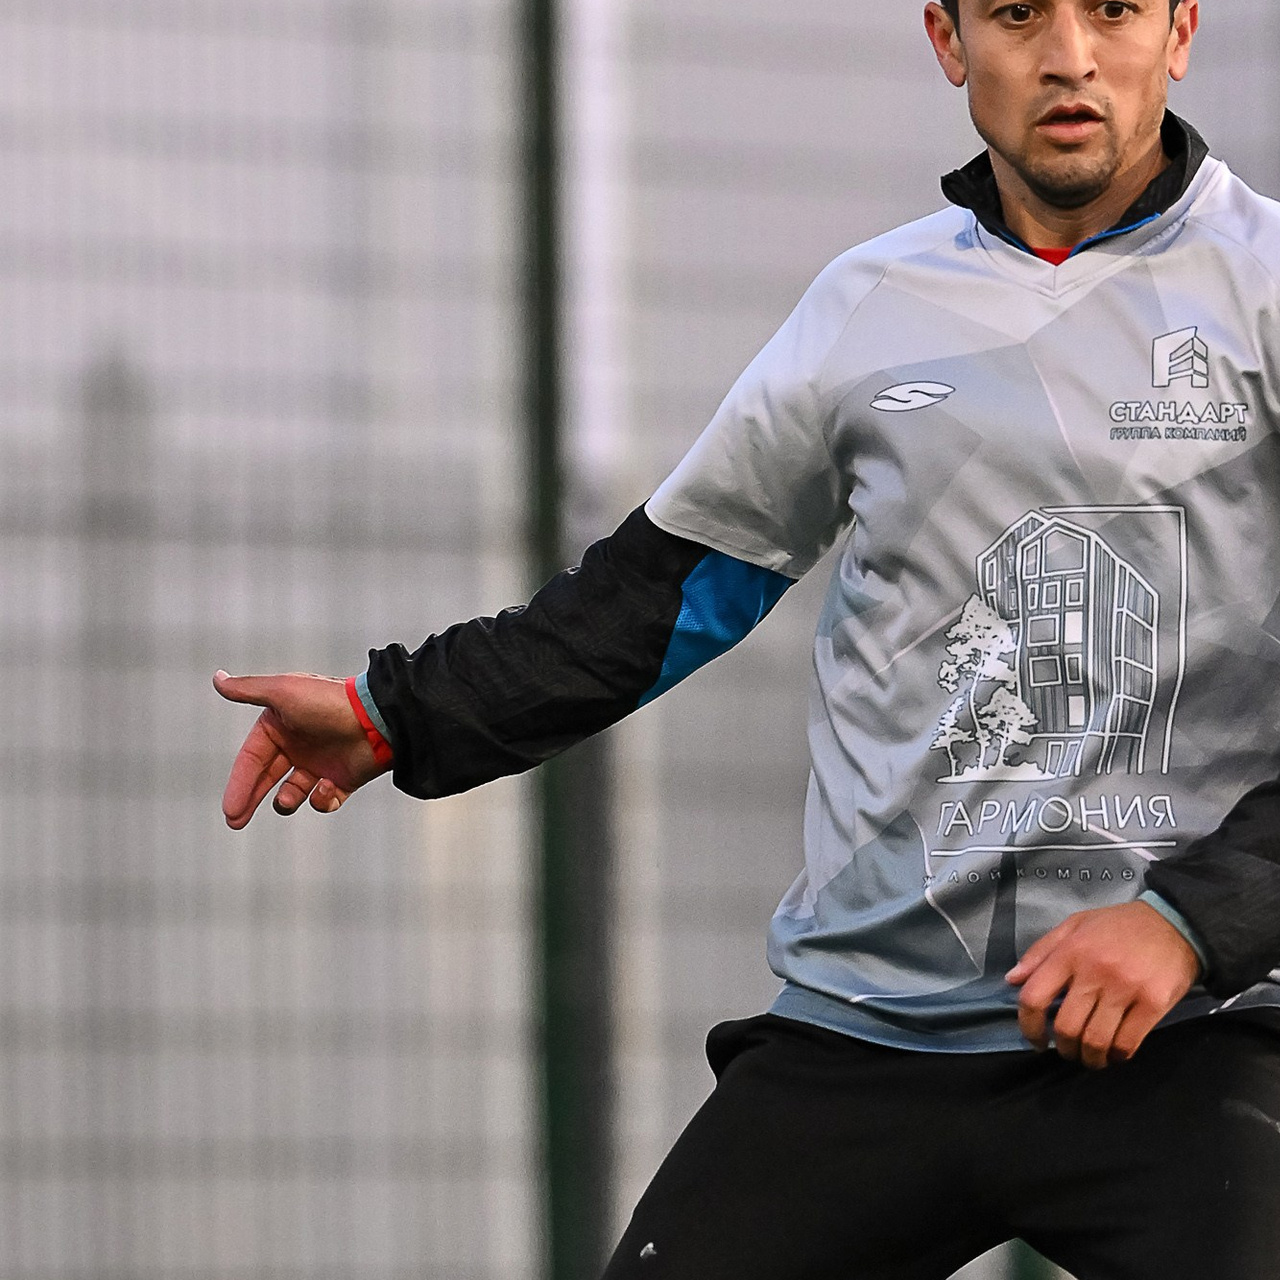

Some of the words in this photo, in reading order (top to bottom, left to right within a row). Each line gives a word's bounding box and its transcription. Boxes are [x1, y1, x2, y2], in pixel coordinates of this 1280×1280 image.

[1109, 400, 1248, 424] СТАНДАРТ
[1109, 426, 1161, 440] ГРУППА
[1164, 426, 1247, 442] КОМПАНИЙ
[935, 795, 1177, 837] ГАРМОНИЯ
